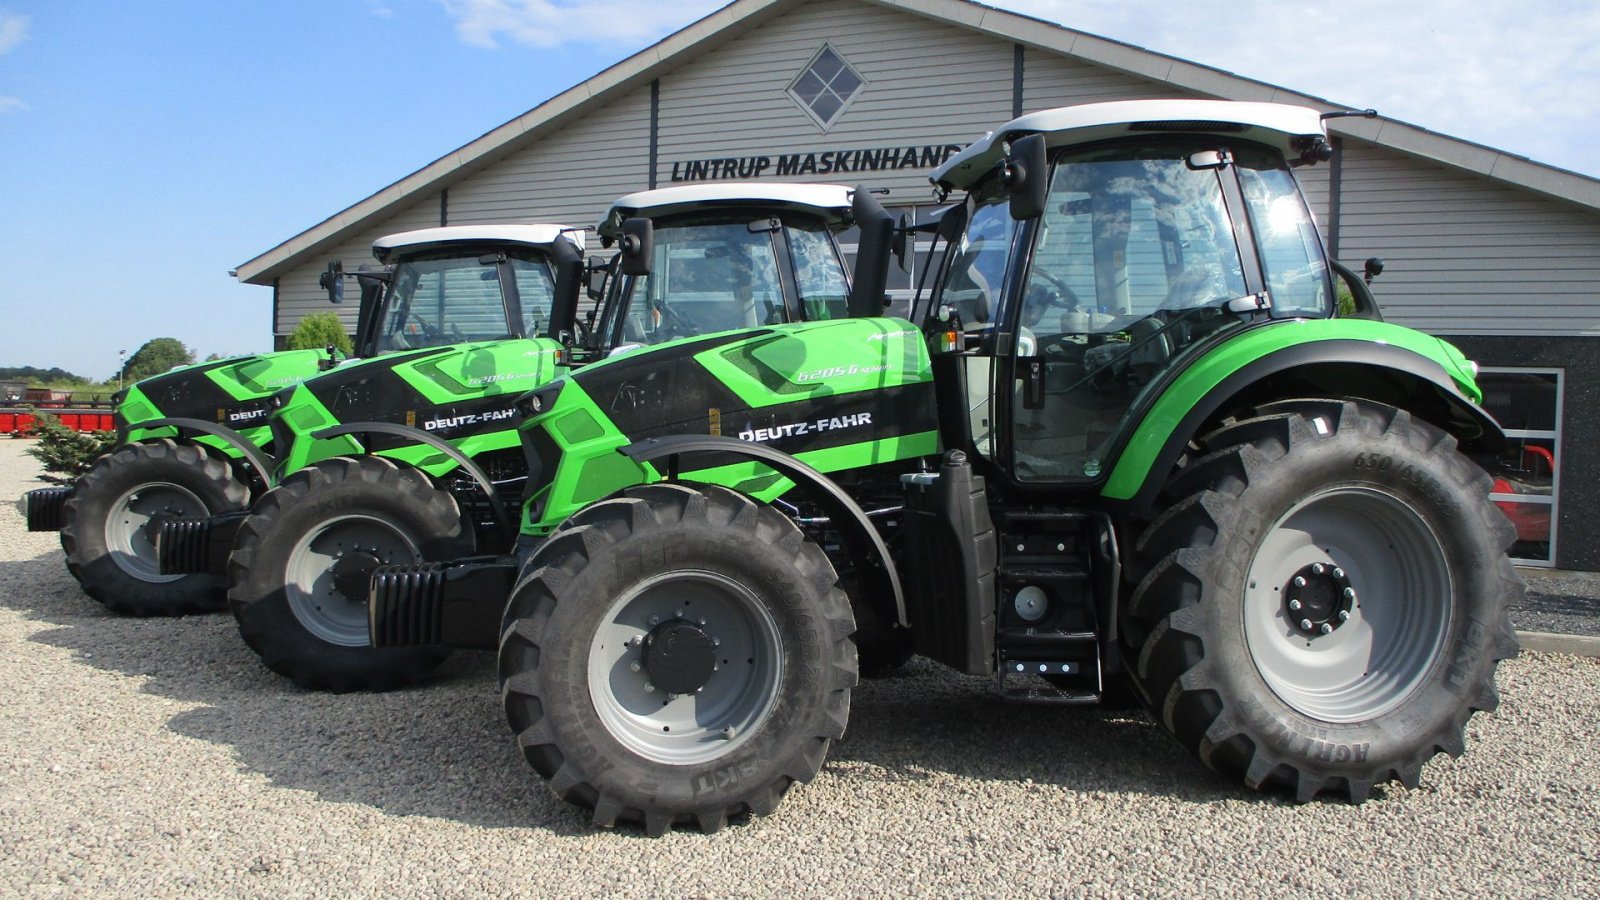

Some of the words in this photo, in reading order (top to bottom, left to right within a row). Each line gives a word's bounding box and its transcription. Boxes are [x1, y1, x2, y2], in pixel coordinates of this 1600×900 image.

[671, 156, 770, 182] LINTRUP
[776, 142, 974, 176] MASKINHAND
[797, 366, 845, 382] 6205
[230, 409, 267, 421] DEUT
[424, 408, 516, 431] DEUTZ-FAH
[738, 412, 872, 443] DEUTZ-FAHR
[691, 752, 760, 800] BKT
